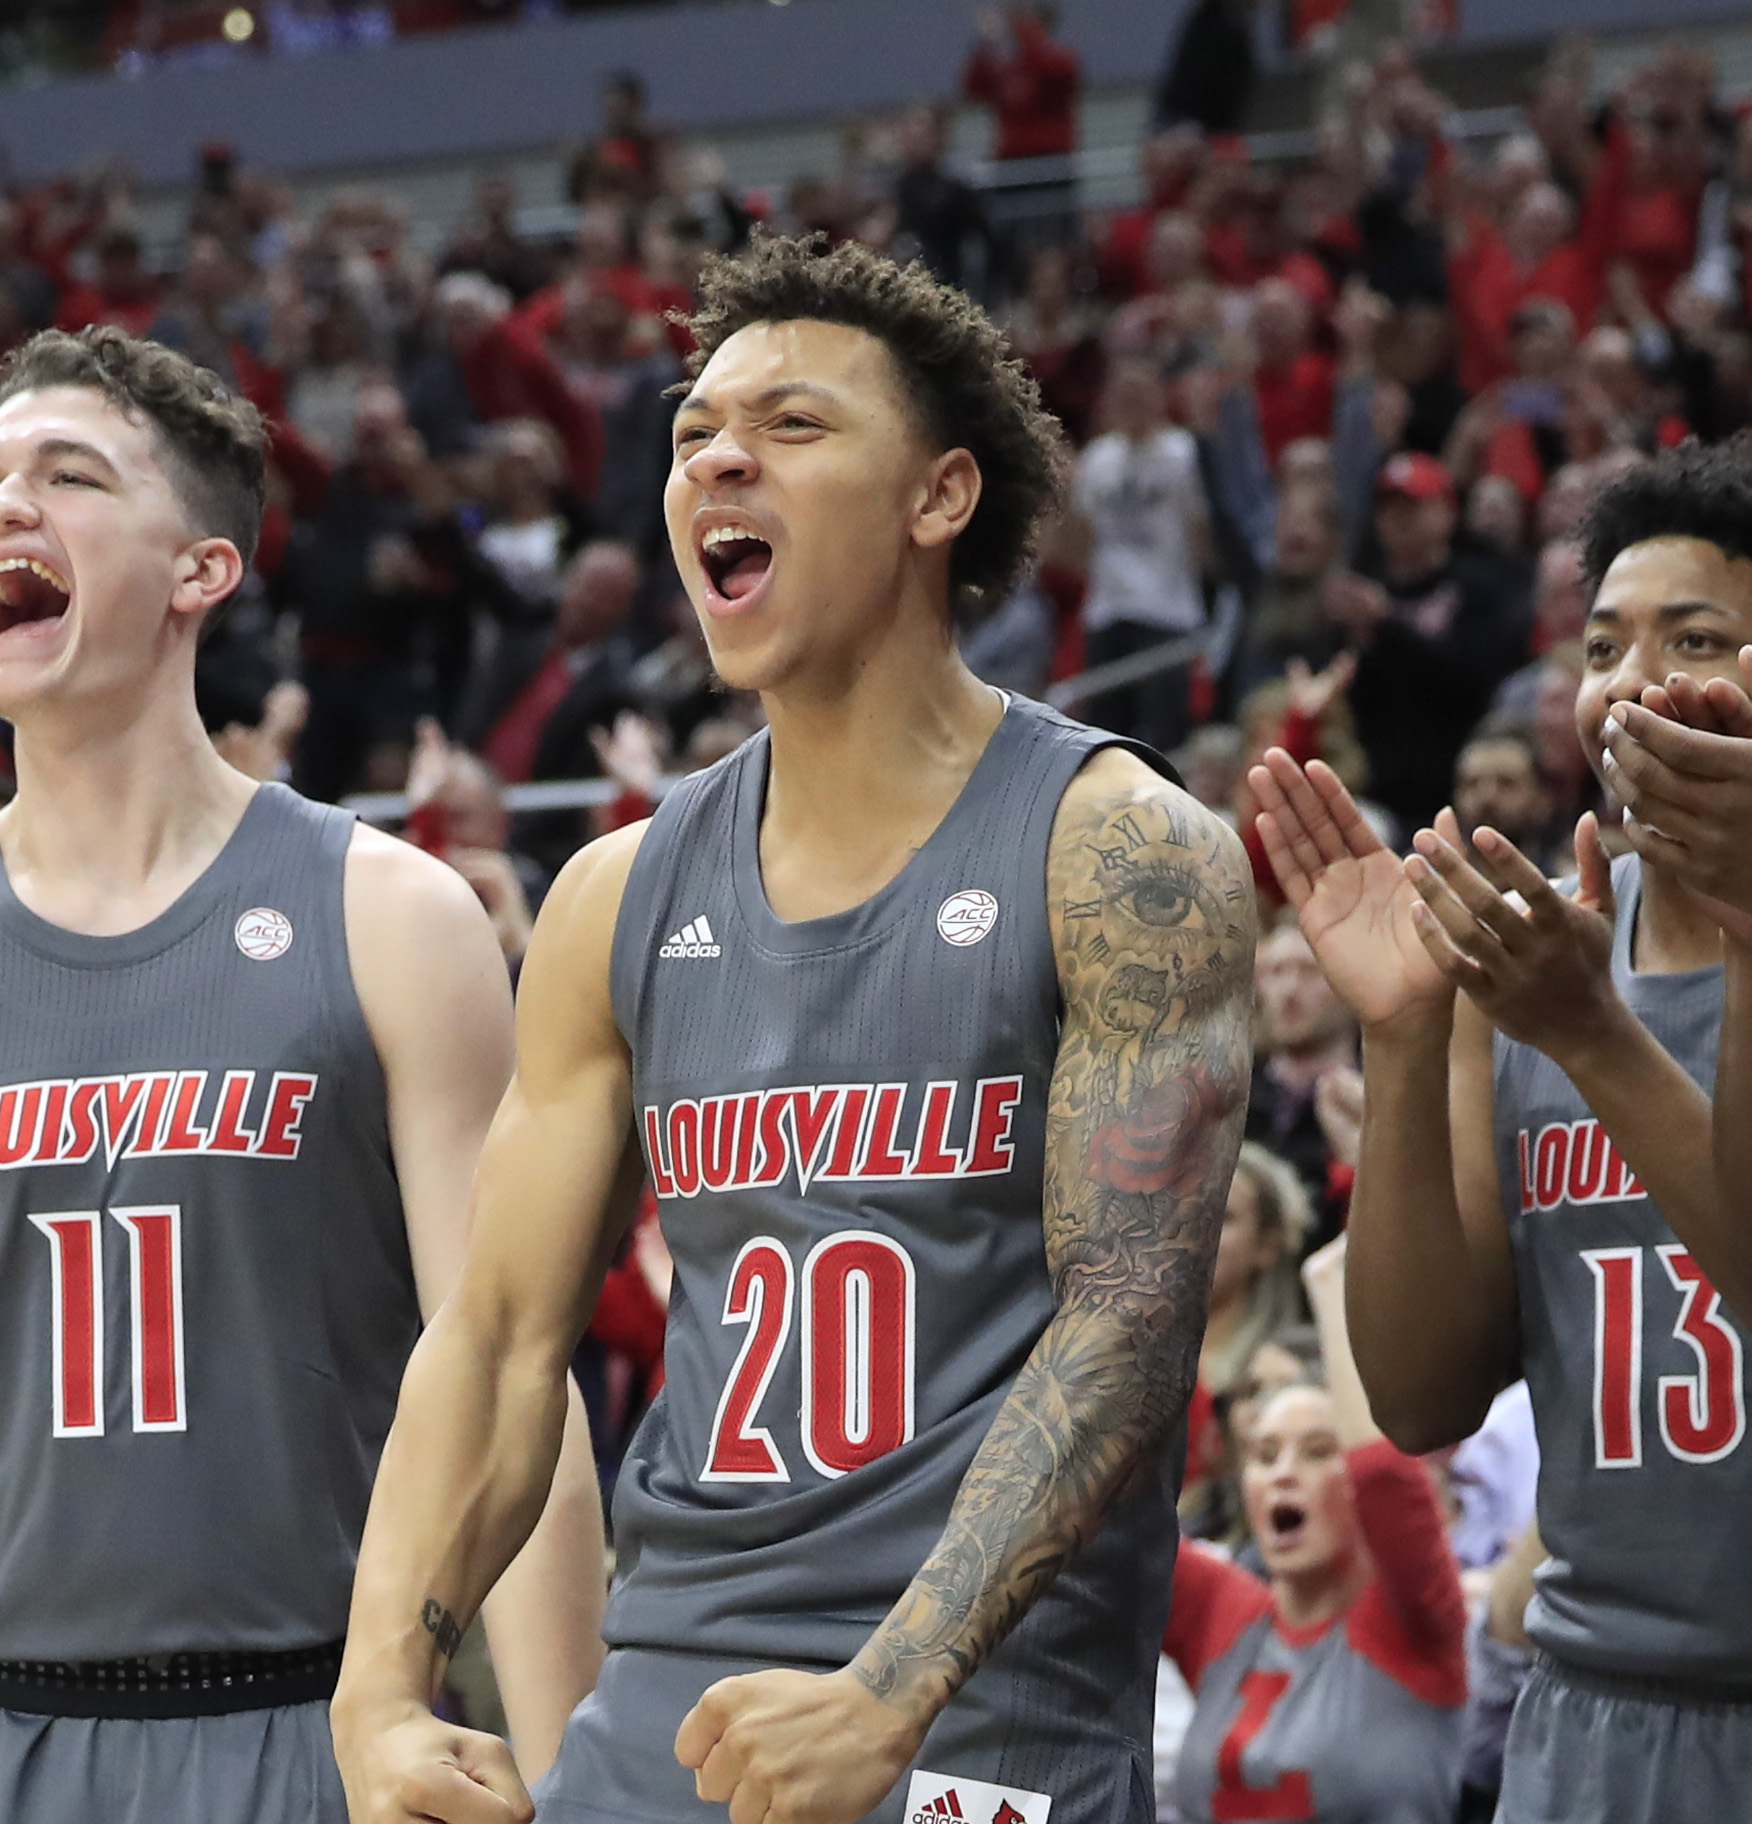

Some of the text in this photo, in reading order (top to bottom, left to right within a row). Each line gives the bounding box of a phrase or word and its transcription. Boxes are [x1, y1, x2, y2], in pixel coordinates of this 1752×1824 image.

[244, 926, 289, 941] ACC
[658, 941, 722, 958] adidas
[949, 906, 993, 922] ACC
[644, 1074, 1024, 1198] LOUISVILLE
[26, 1203, 188, 1439] 11
[698, 1229, 917, 1484] 20
[1578, 1243, 1747, 1470] 13
[1211, 1668, 1315, 1824] L
